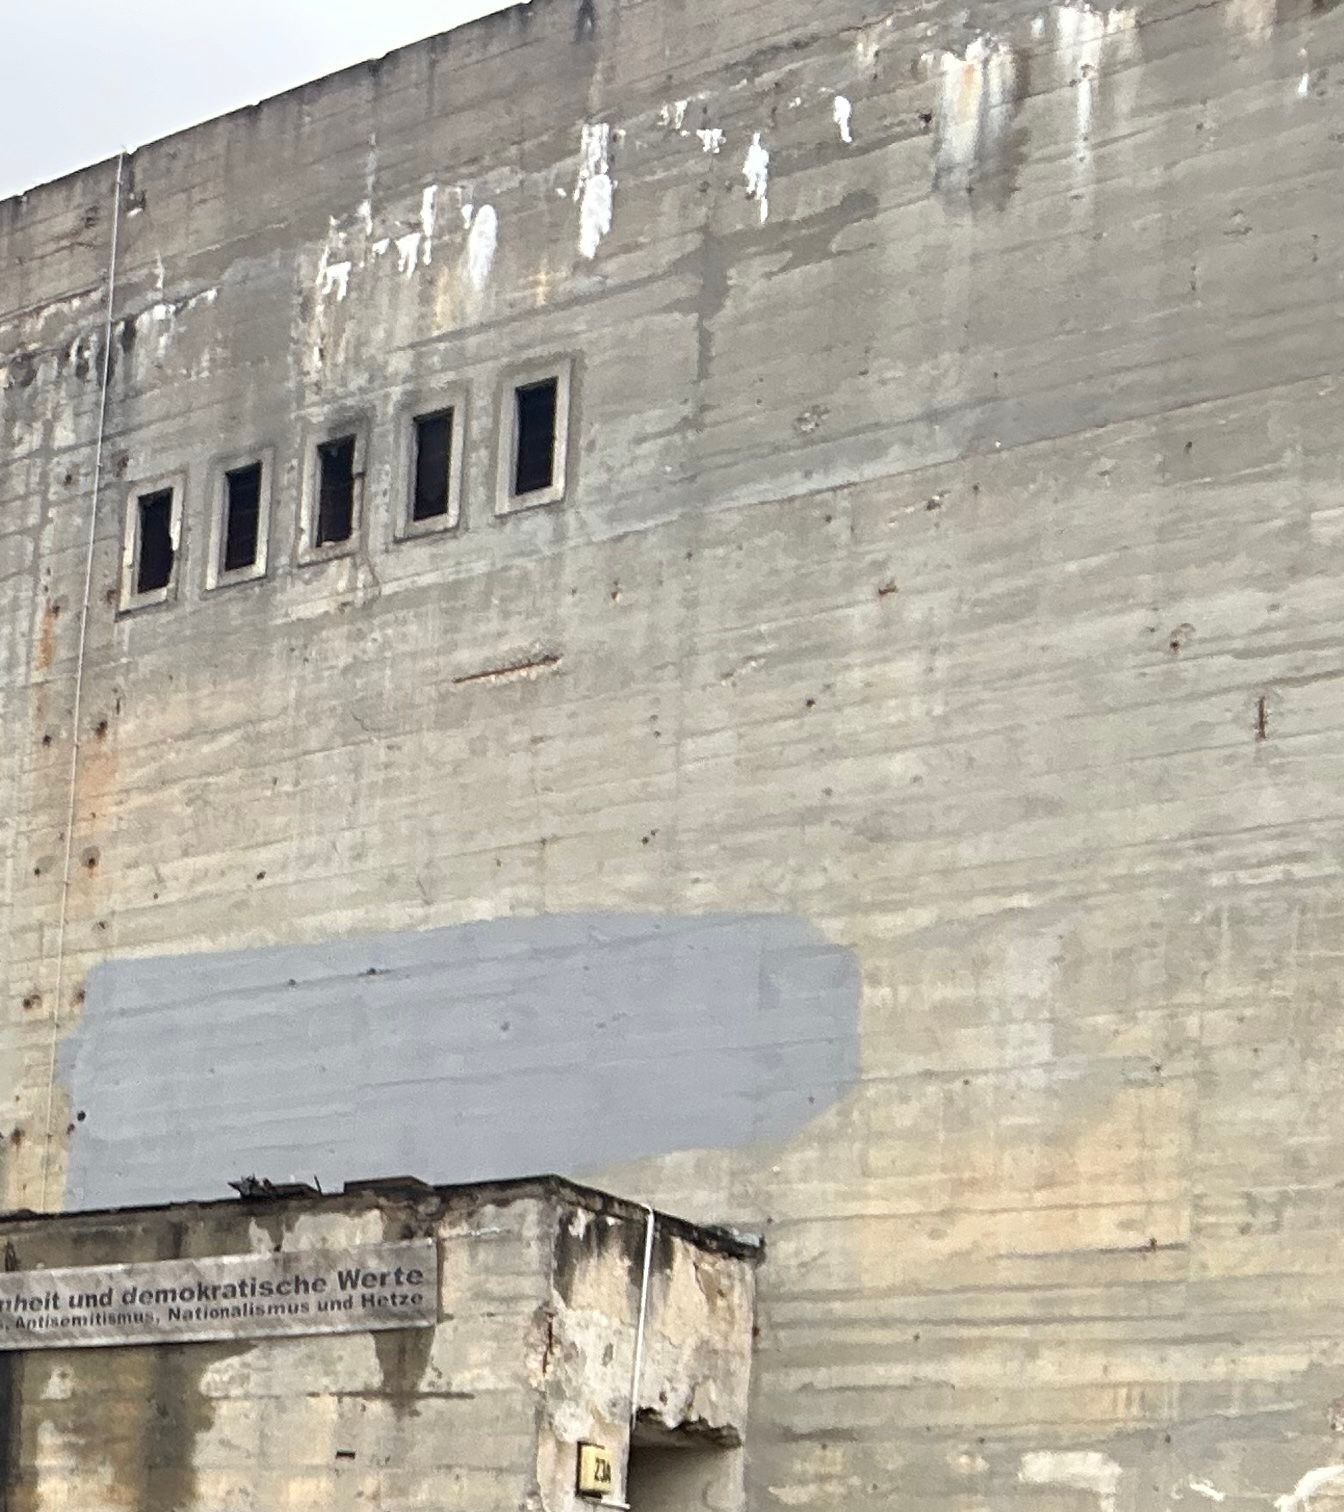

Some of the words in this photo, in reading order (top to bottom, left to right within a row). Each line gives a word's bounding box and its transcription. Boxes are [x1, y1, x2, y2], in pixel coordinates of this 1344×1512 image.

[68, 1287, 113, 1310] und
[121, 1274, 328, 1306] demokratische
[337, 1266, 424, 1291] Werte
[15, 1309, 161, 1330] Antisemitismus,
[168, 1301, 310, 1322] Nationalismus
[317, 1295, 353, 1312] und
[361, 1291, 424, 1309] Hetze
